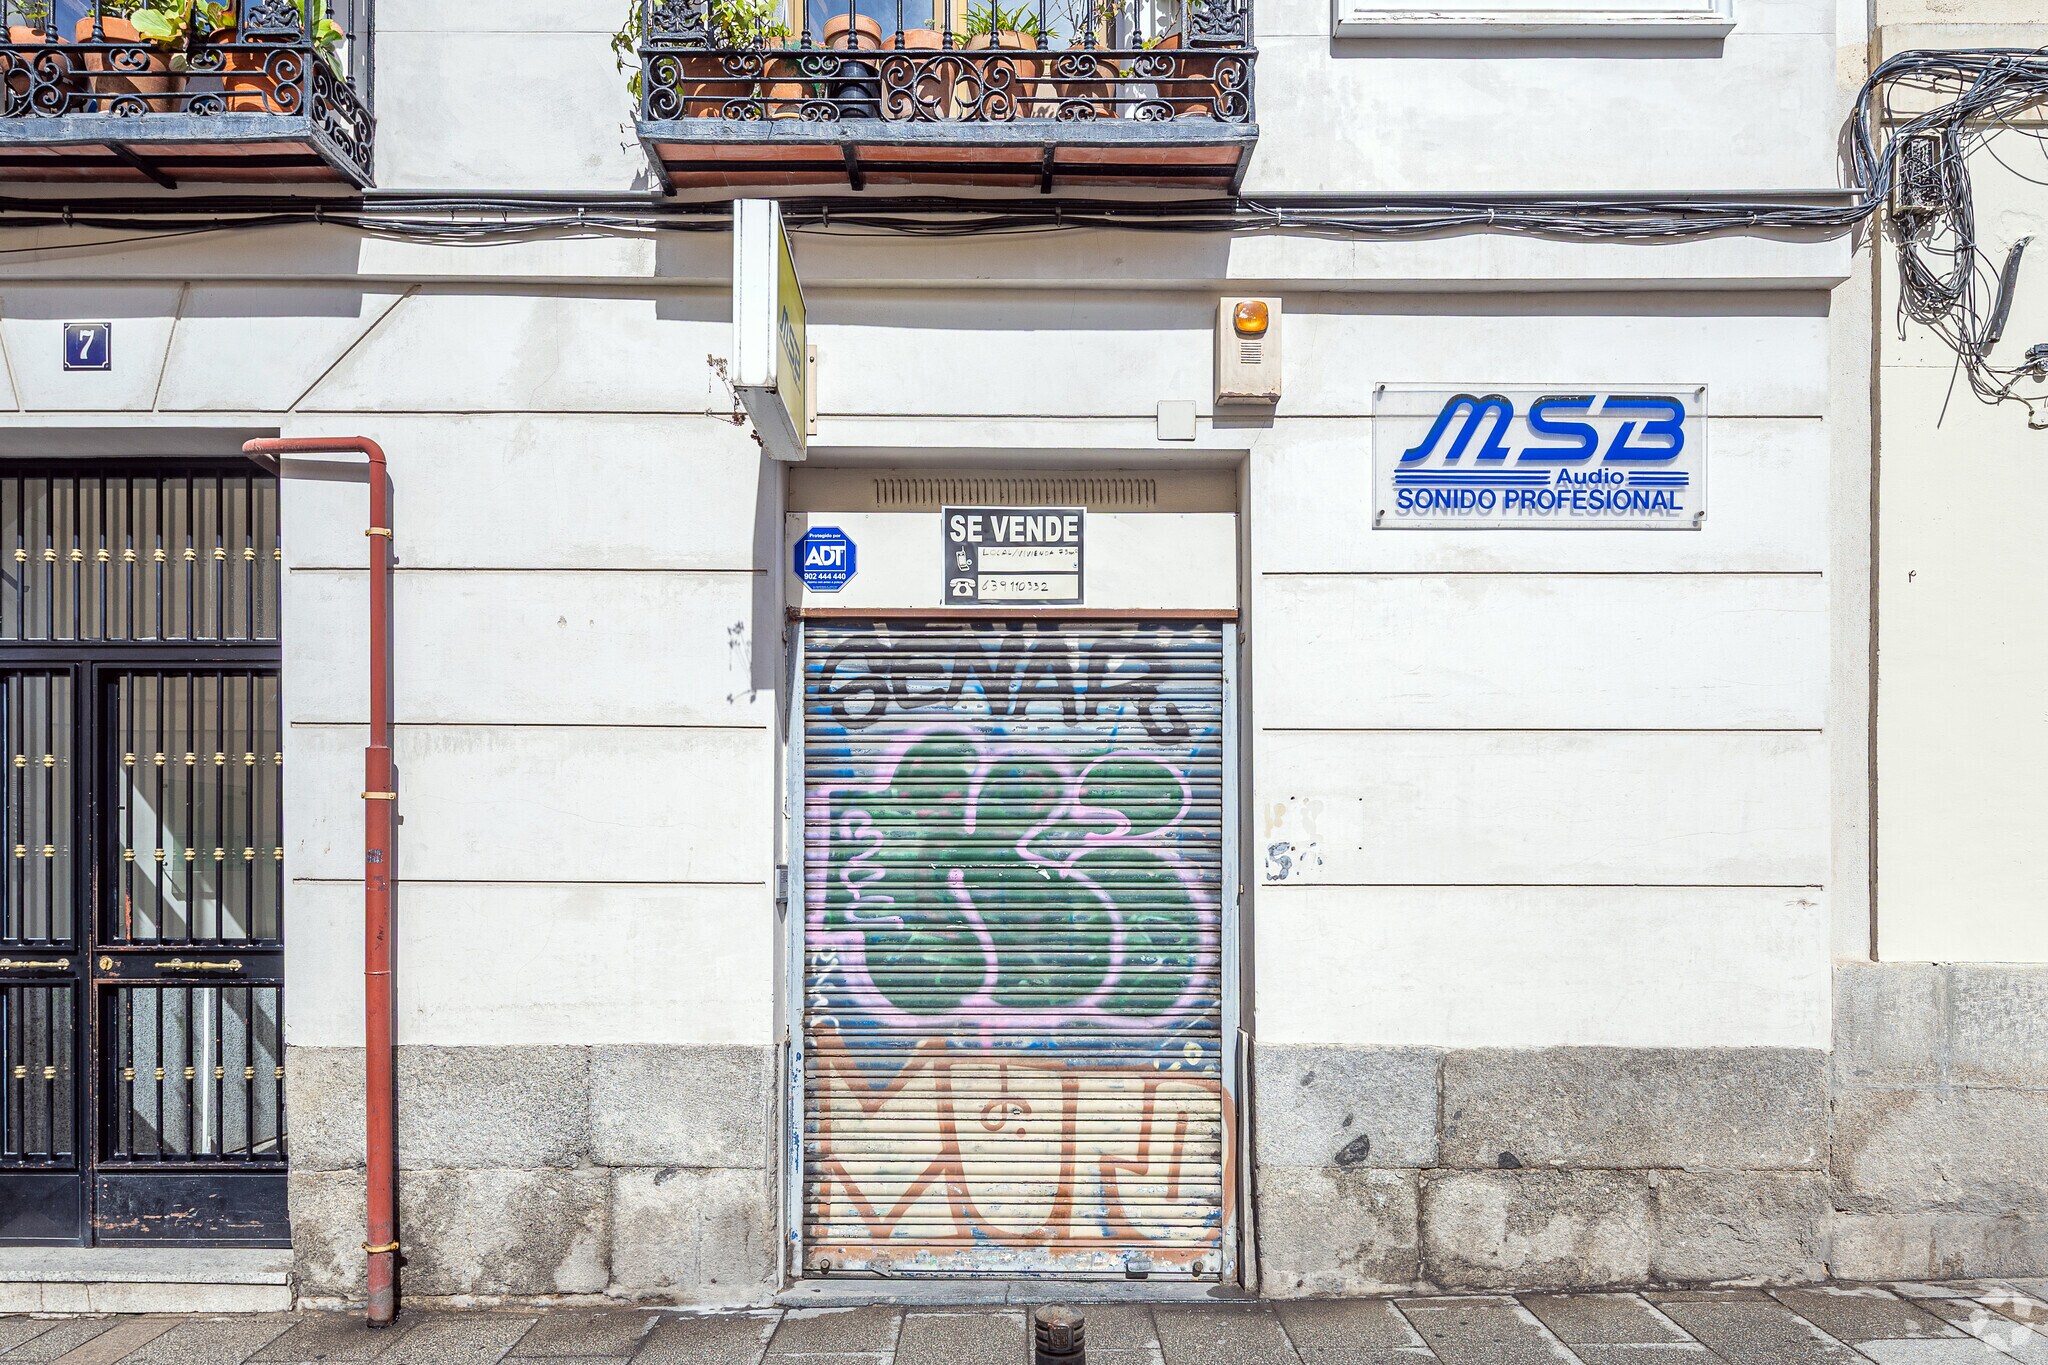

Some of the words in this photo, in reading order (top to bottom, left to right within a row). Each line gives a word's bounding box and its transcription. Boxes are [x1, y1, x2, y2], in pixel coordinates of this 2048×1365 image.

[80, 330, 95, 360] 7
[1400, 393, 1686, 462] MSB
[1556, 467, 1625, 485] Audio
[1397, 488, 1497, 510] SONIDO
[1504, 489, 1683, 510] PROFESIONAL
[950, 514, 983, 543] SE
[991, 515, 1079, 542] VENDE
[804, 545, 846, 566] ADT
